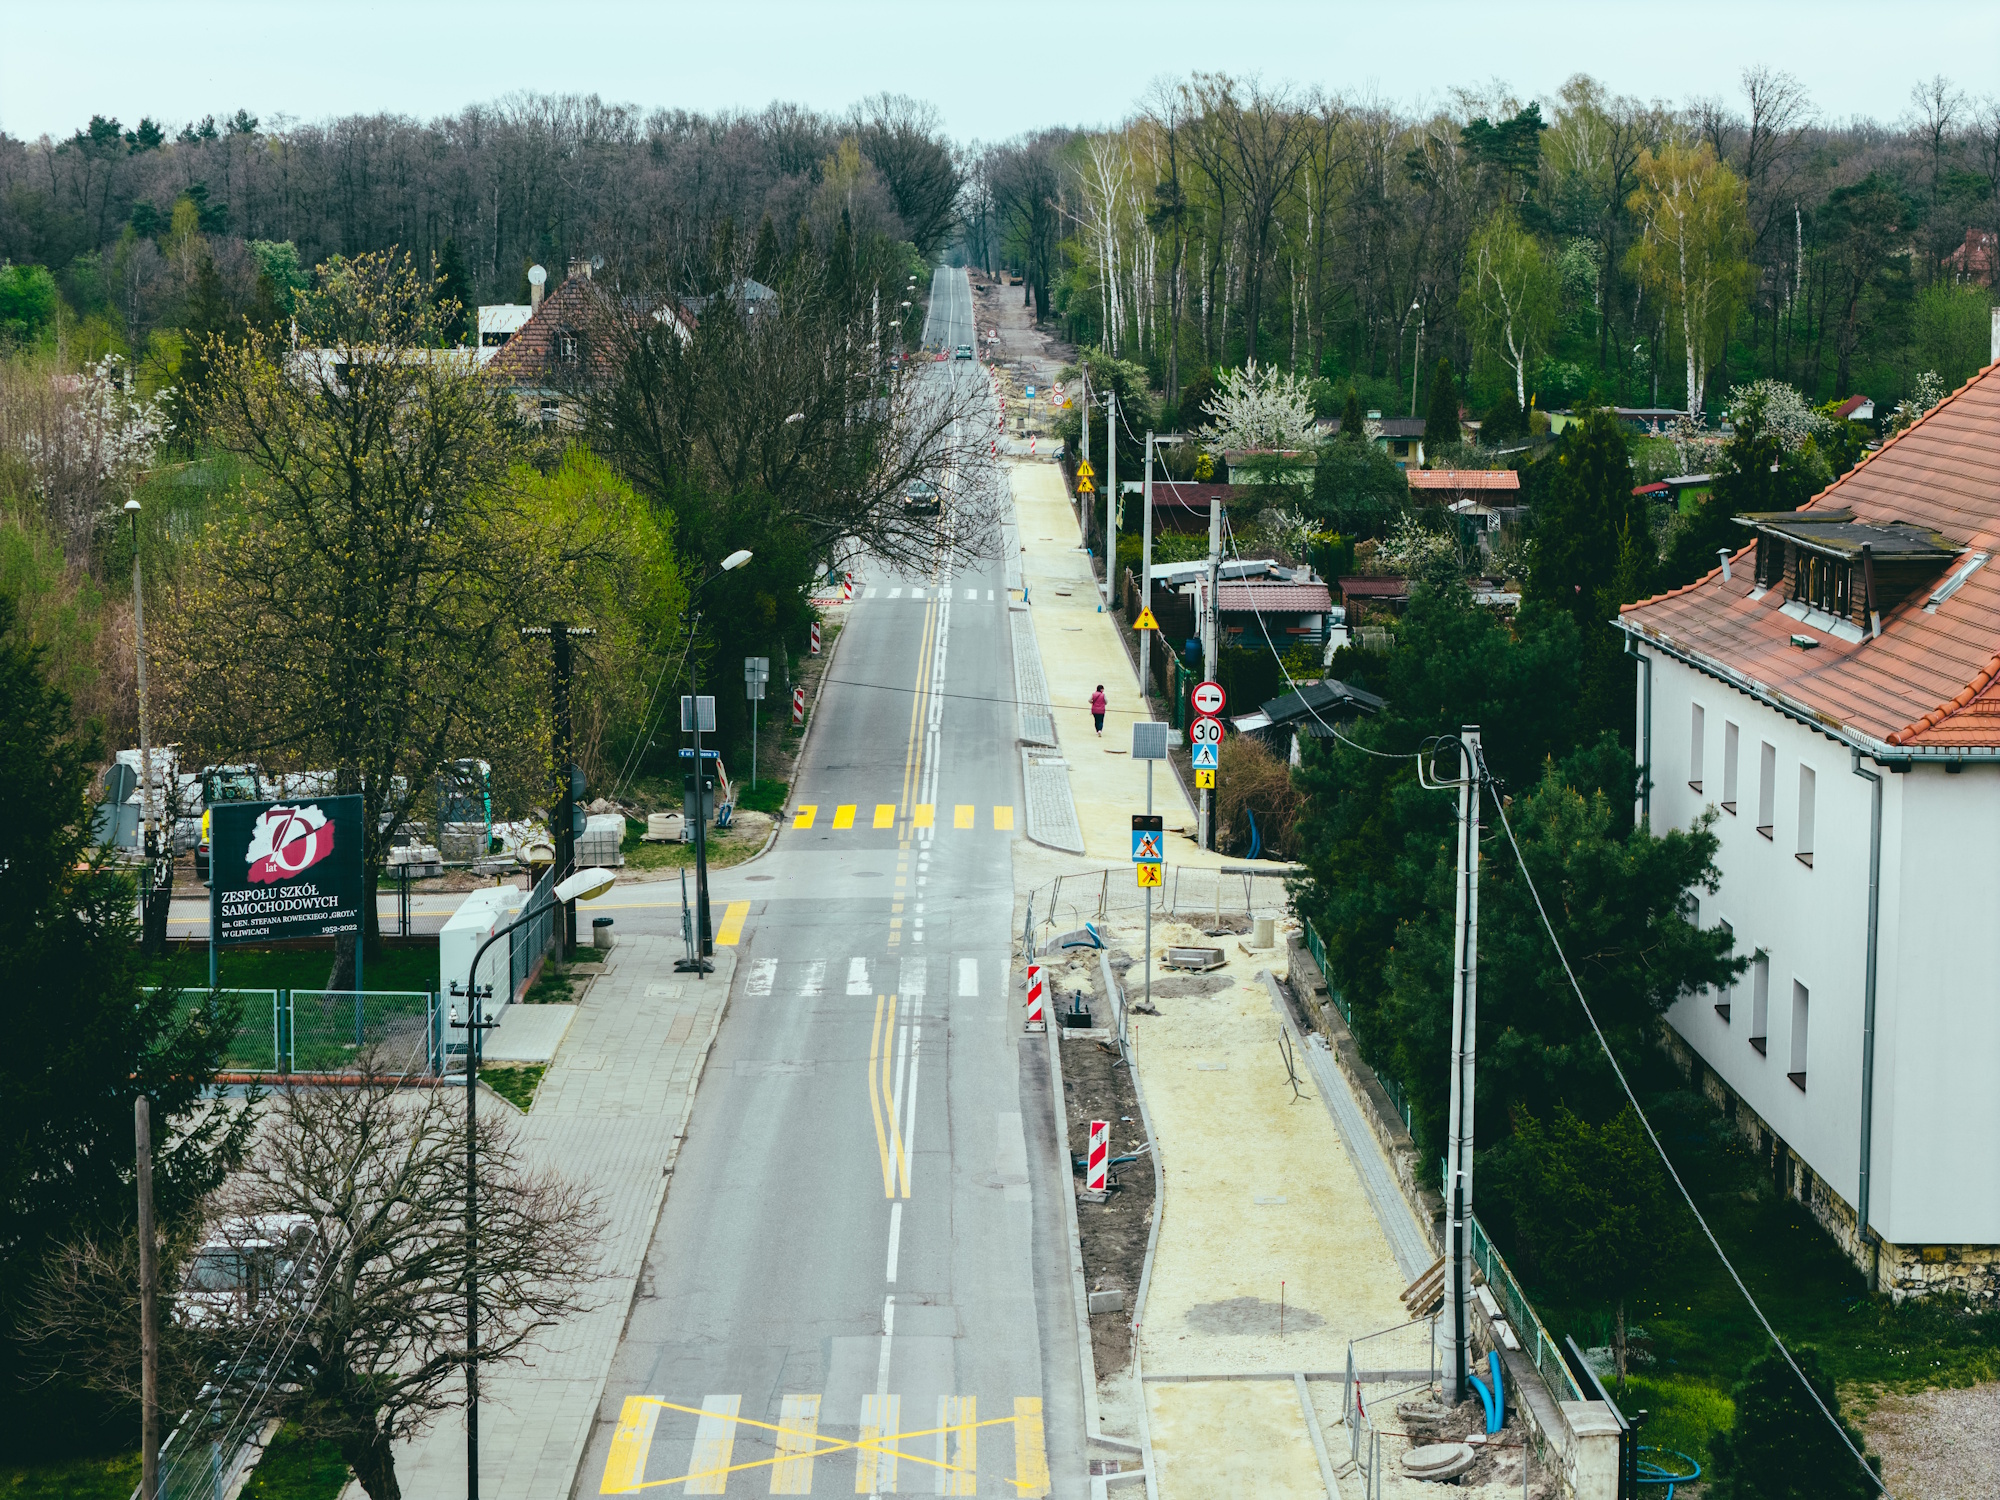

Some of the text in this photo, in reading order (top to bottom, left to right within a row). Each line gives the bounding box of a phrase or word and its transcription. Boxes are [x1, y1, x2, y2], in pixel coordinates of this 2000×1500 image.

[1195, 724, 1219, 741] 30
[265, 809, 317, 871] 70
[265, 863, 277, 872] lat
[222, 882, 319, 903] ZESPOŁU SZKÓŁ
[222, 896, 338, 916] SAMOCHODOWYCH
[251, 917, 281, 926] STEFANA
[282, 912, 328, 922] ROWECKIEGO
[230, 928, 269, 937] GLIWICACH
[322, 924, 357, 933] 1952-2022
